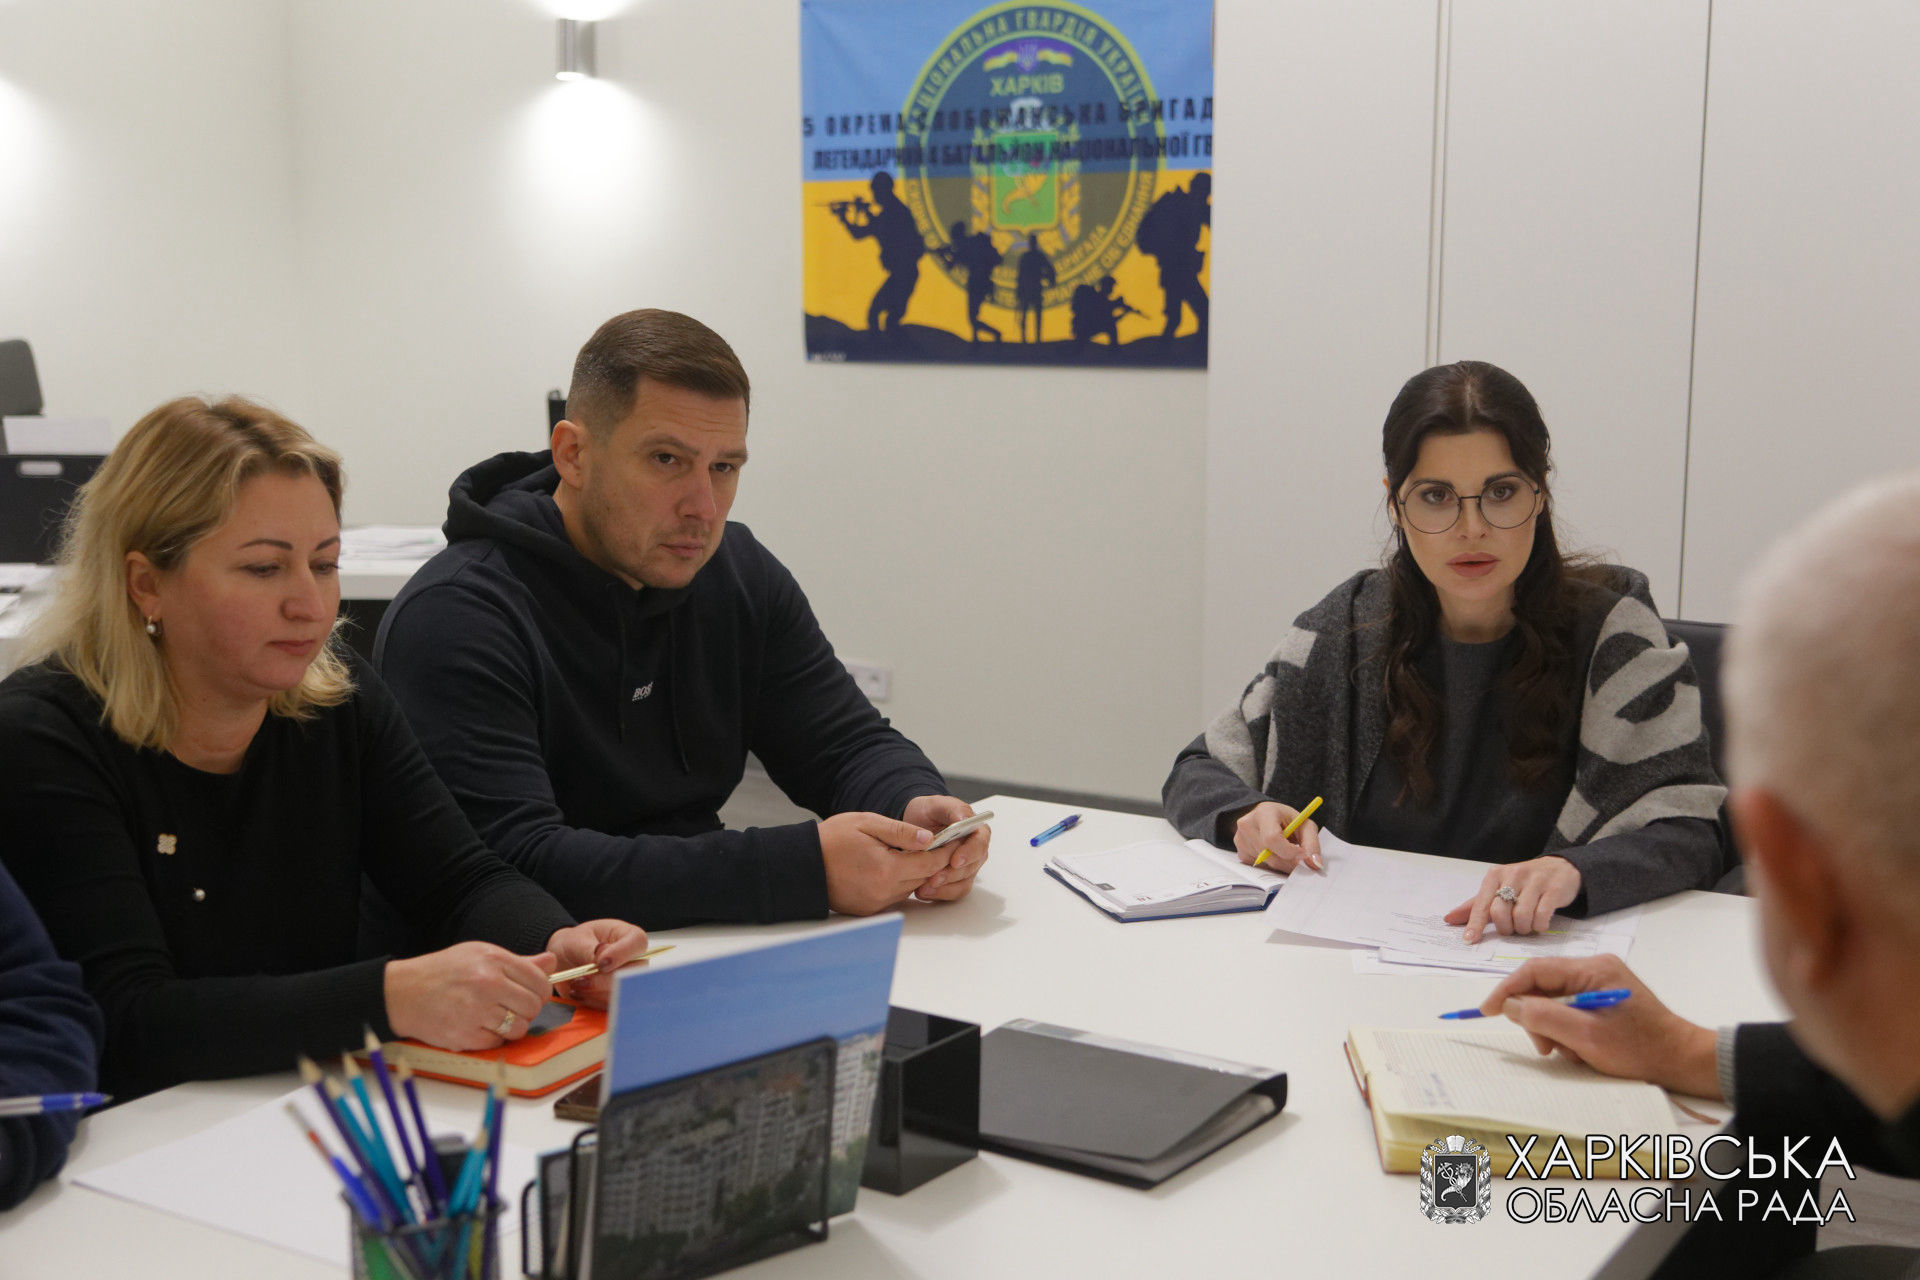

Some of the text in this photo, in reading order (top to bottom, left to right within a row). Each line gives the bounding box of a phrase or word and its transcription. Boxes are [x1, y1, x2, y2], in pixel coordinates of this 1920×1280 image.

[1015, 9, 1098, 47] ГВАРДІЯ
[989, 73, 1065, 98] ХАРКІВ
[826, 112, 905, 137] ОКРЕМА
